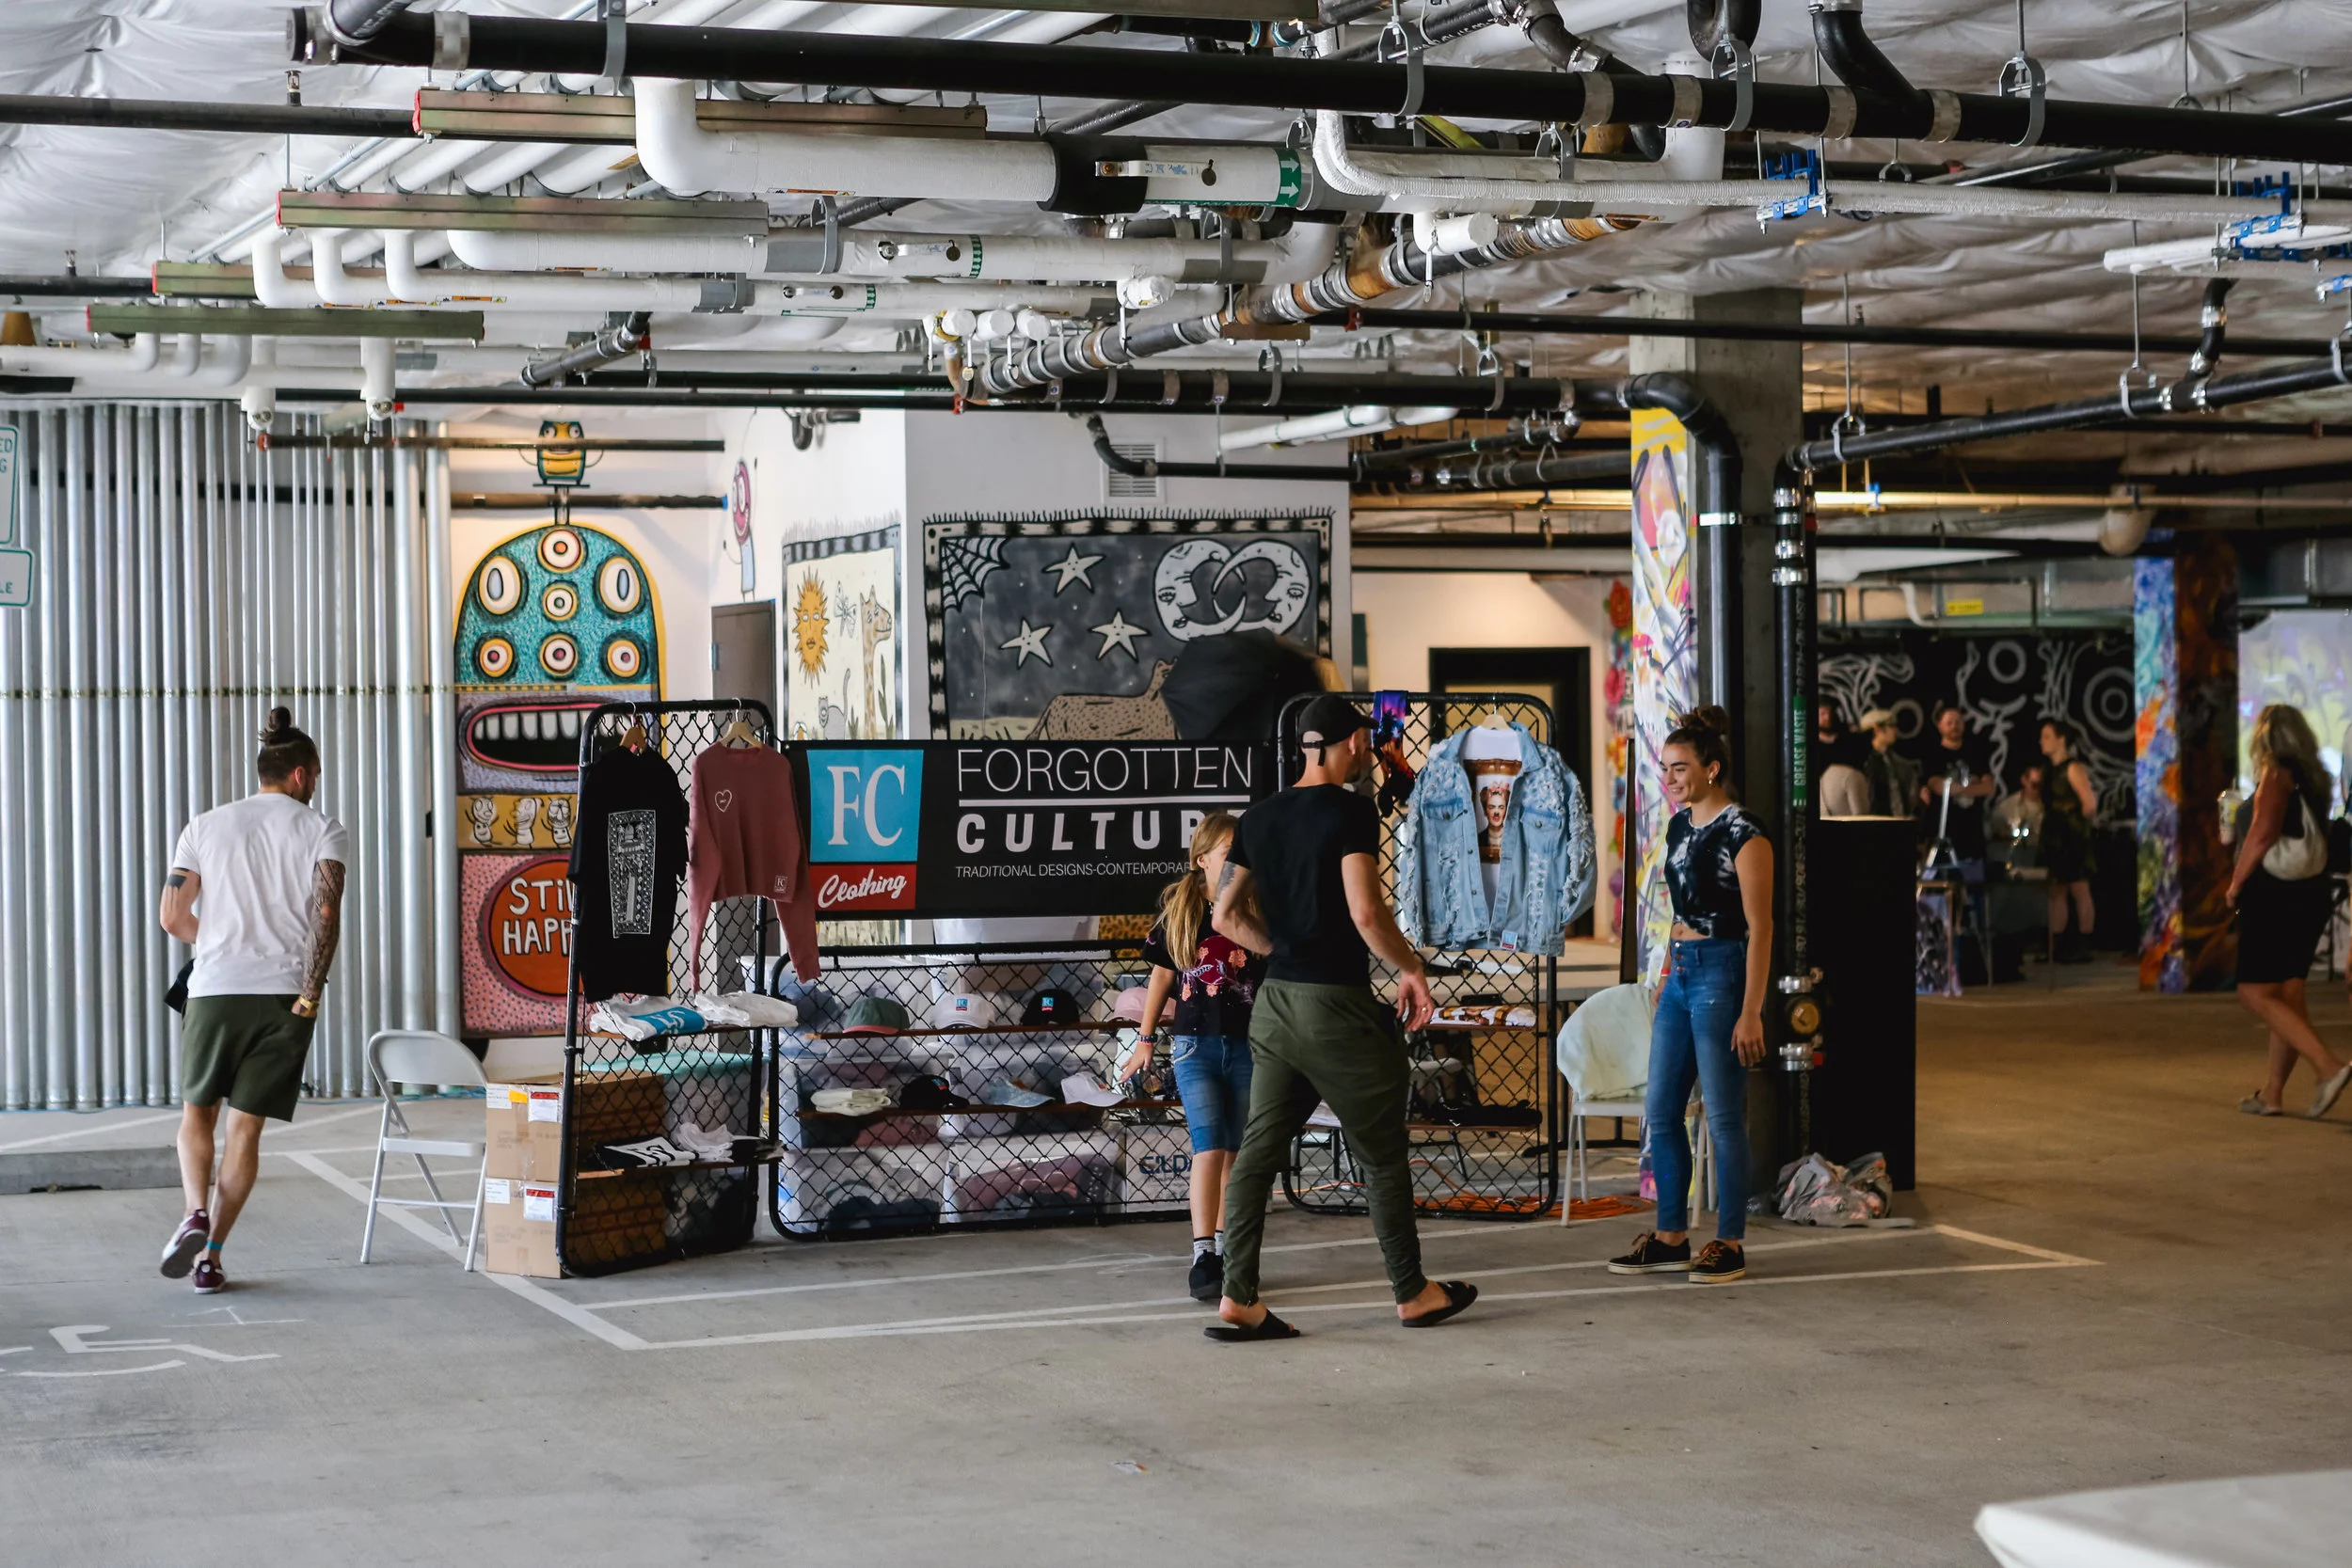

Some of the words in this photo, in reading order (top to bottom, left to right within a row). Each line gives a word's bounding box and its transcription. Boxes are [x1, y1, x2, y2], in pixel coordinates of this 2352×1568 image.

[1793, 709, 1806, 744] WASTE
[958, 747, 1251, 792] FORGOTTEN
[1793, 747, 1806, 785] GREASE
[827, 764, 905, 847] FC
[957, 810, 1246, 854] CULTUR
[777, 878, 786, 887] FC
[818, 868, 907, 909] Clothing
[955, 864, 1037, 879] TRADITIONAL
[1039, 862, 1190, 876] DESIGNS-CONTEMPORAR
[502, 917, 571, 957] HAPP
[1139, 1154, 1192, 1175] GILD
